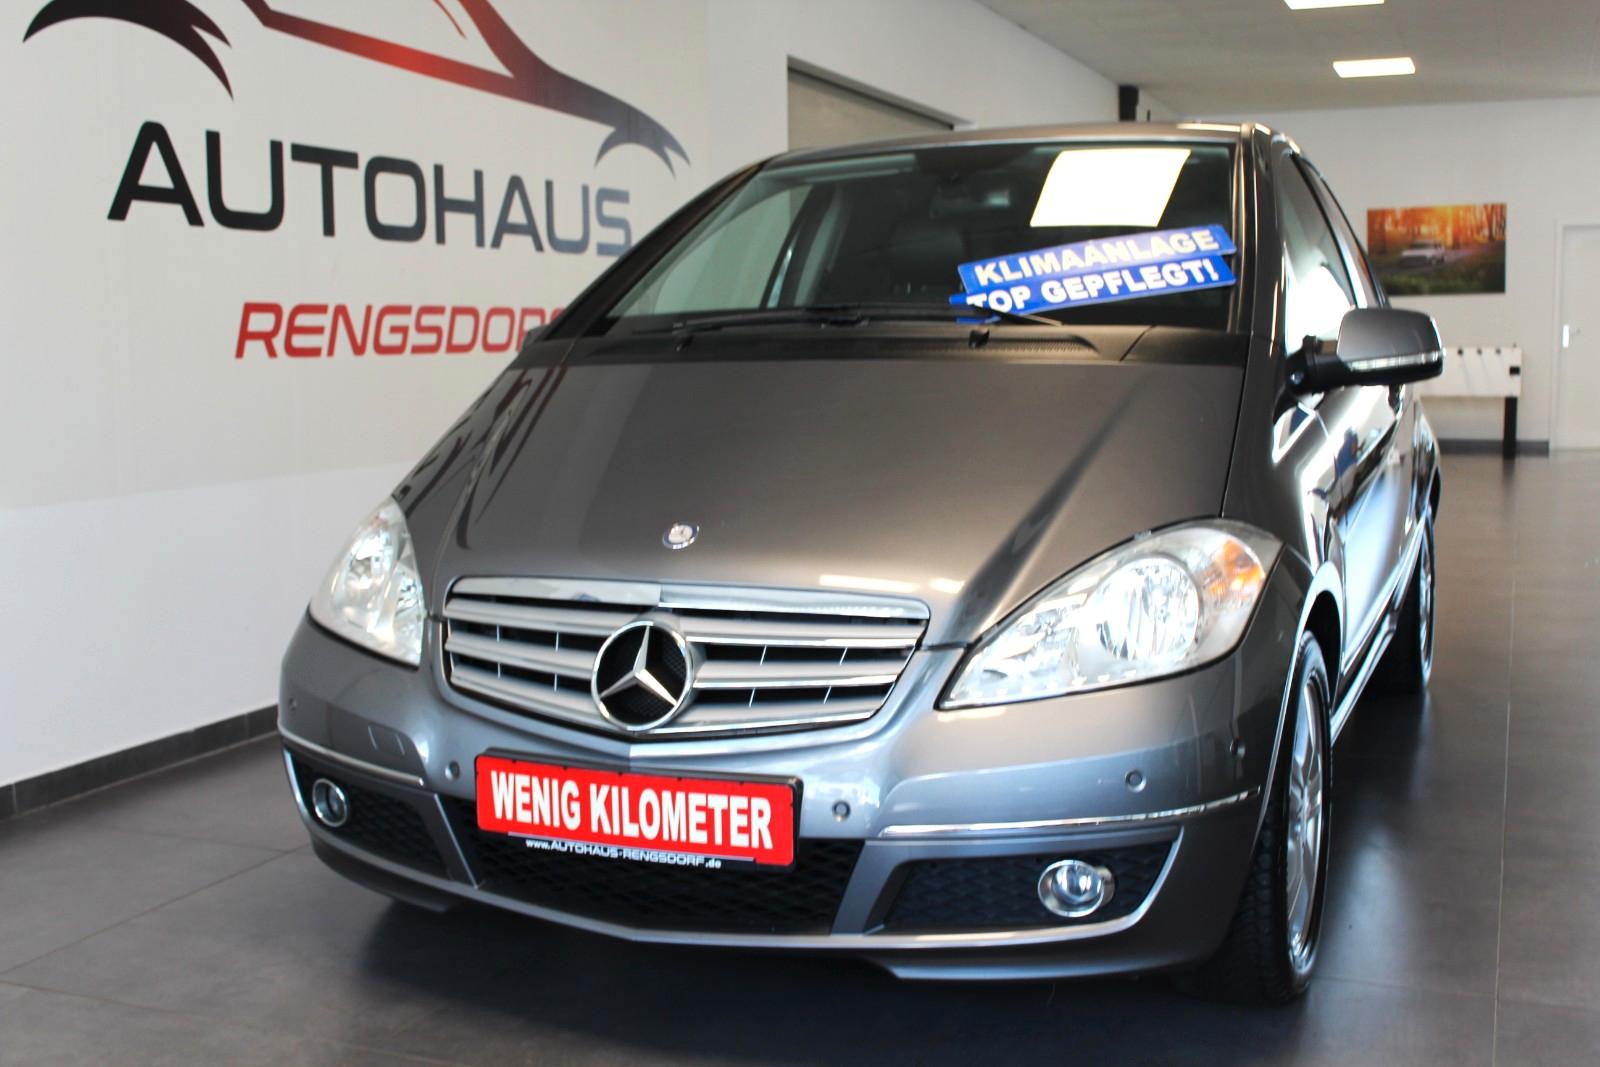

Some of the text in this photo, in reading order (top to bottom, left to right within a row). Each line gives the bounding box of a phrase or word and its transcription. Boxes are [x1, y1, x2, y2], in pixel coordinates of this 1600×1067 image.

[107, 120, 633, 258] AUTOHAUS
[974, 229, 1219, 287] KLIMAANLAGE
[1041, 258, 1219, 304] GEPFLEGT!
[235, 302, 563, 358] RENGSDOR
[490, 770, 773, 850] WENIG KILOMETER
